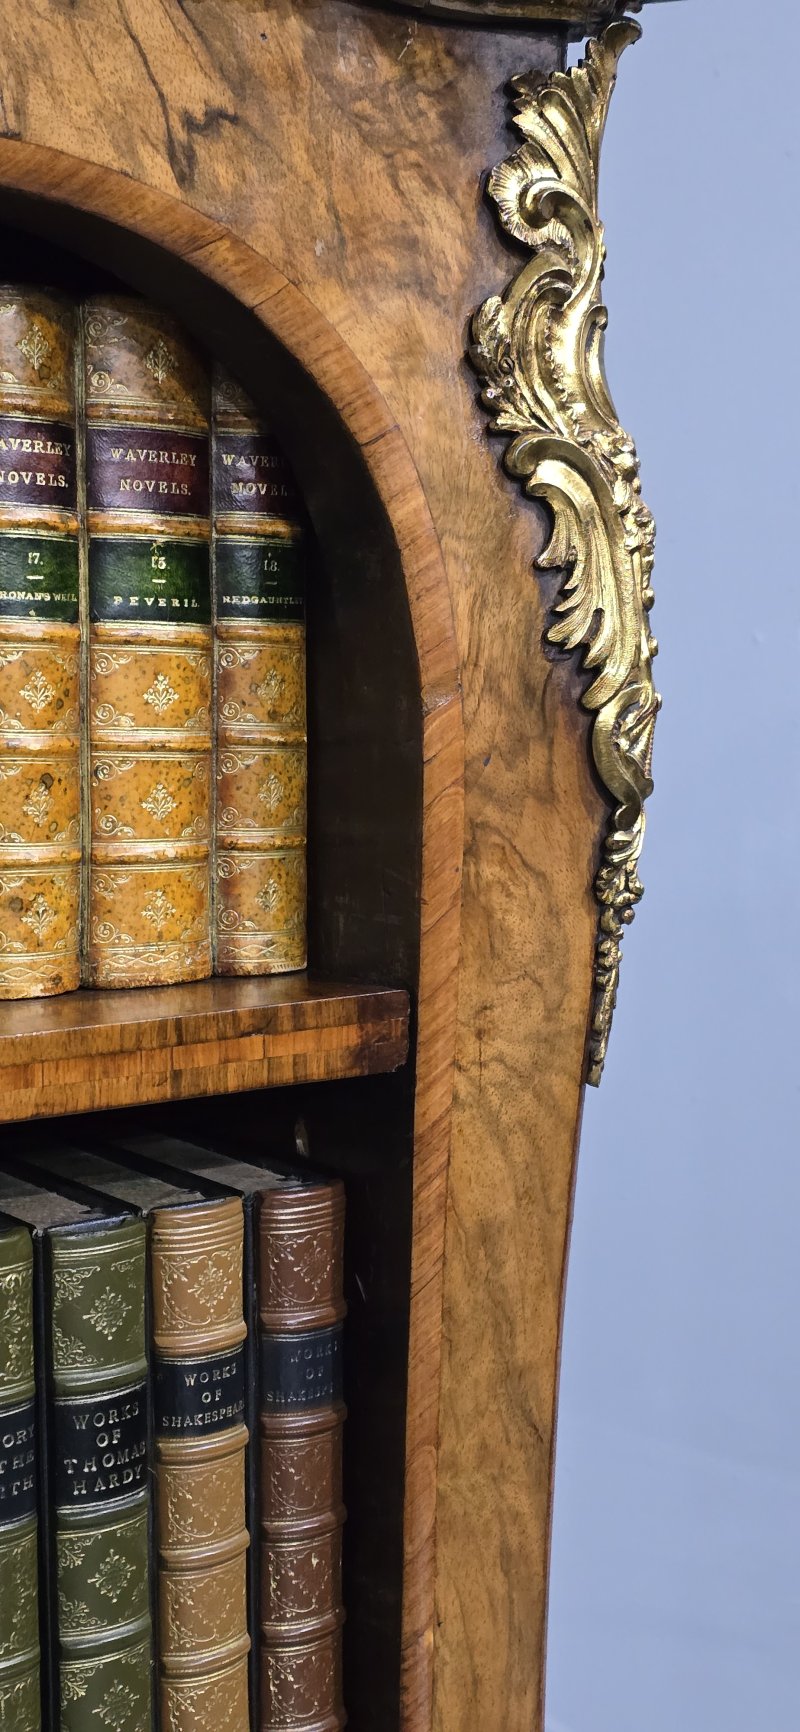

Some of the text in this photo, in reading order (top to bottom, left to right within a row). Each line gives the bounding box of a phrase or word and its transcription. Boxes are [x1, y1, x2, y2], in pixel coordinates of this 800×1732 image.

[110, 447, 197, 467] WAVERLEY
[120, 478, 192, 496] NOVELS.
[28, 552, 44, 566] 17.
[184, 1362, 238, 1388] WORKS
[201, 1389, 222, 1404] OF
[73, 1402, 139, 1430] WORKS
[96, 1428, 121, 1448] OF
[63, 1441, 146, 1475] THOMAS
[73, 1464, 144, 1496] HARDY
